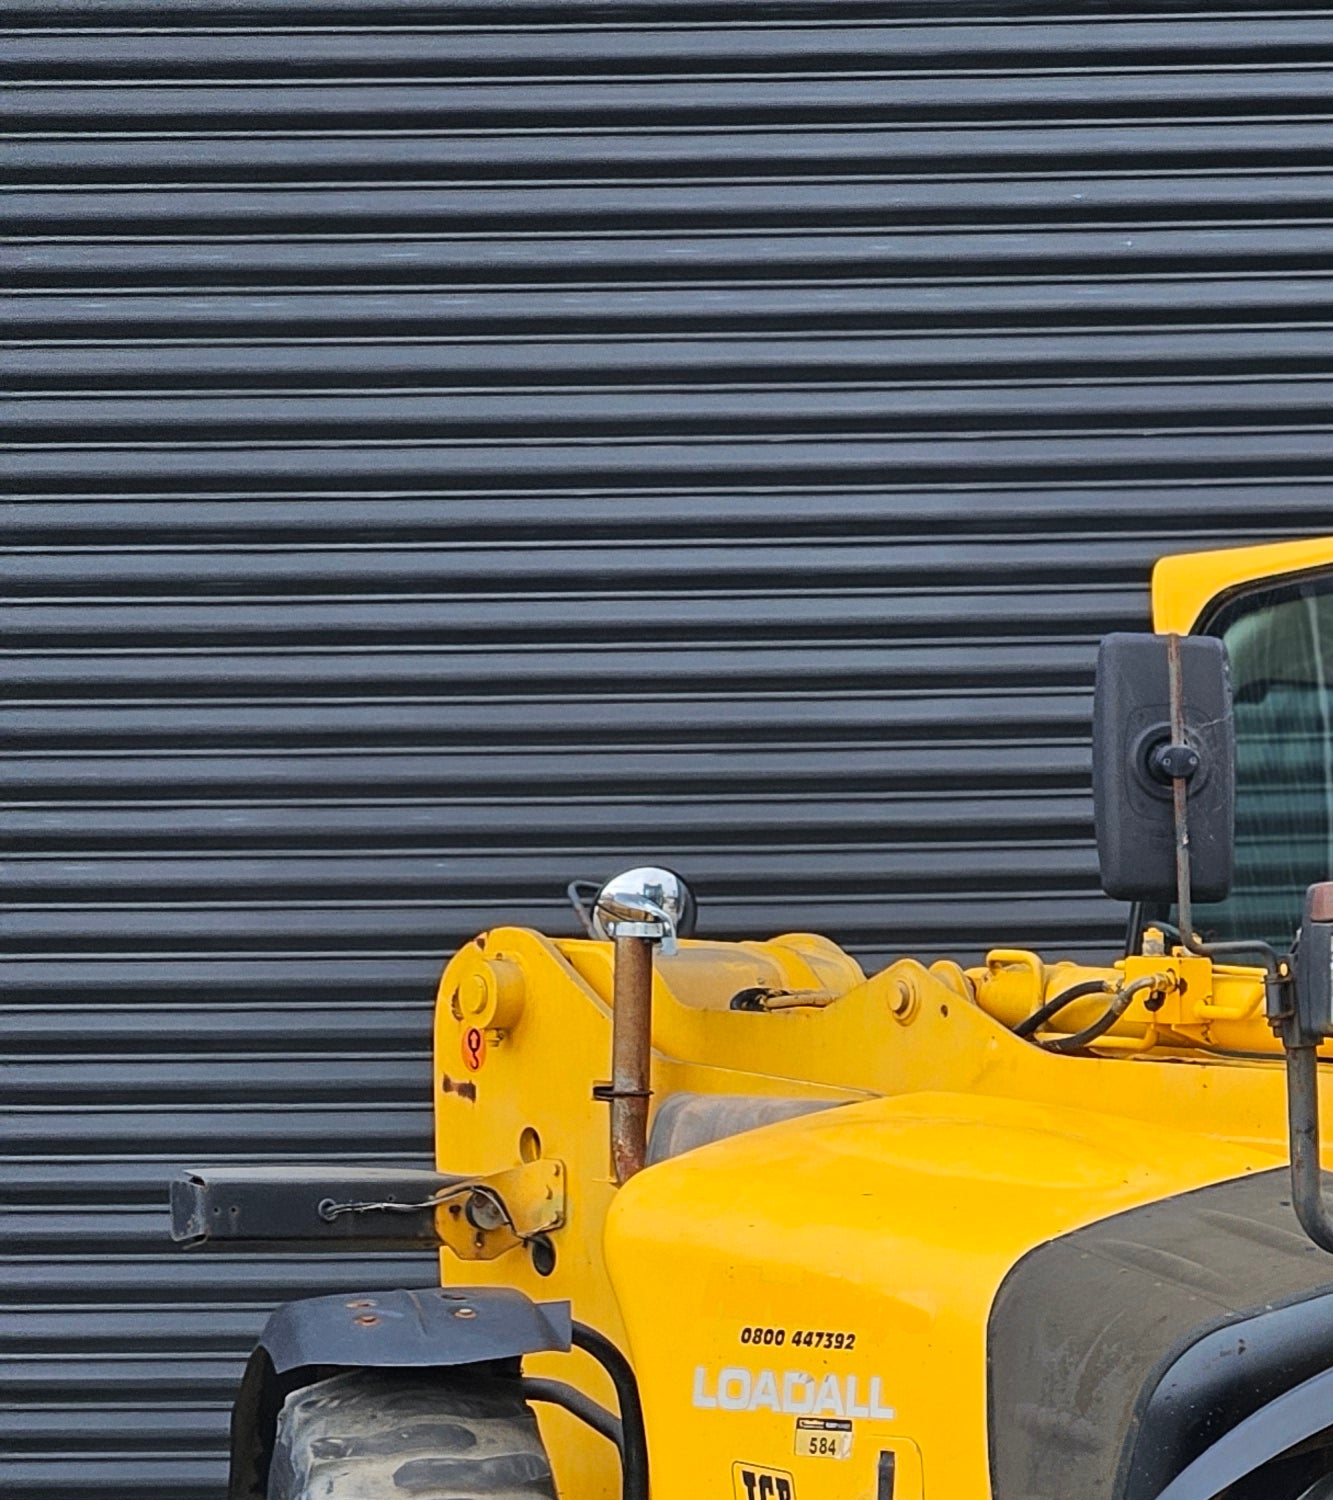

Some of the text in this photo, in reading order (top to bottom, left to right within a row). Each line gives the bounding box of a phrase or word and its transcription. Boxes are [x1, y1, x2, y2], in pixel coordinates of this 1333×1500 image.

[740, 1327, 856, 1350] 0800 447392
[692, 1366, 895, 1420] LOADALL
[808, 1436, 837, 1456] 584
